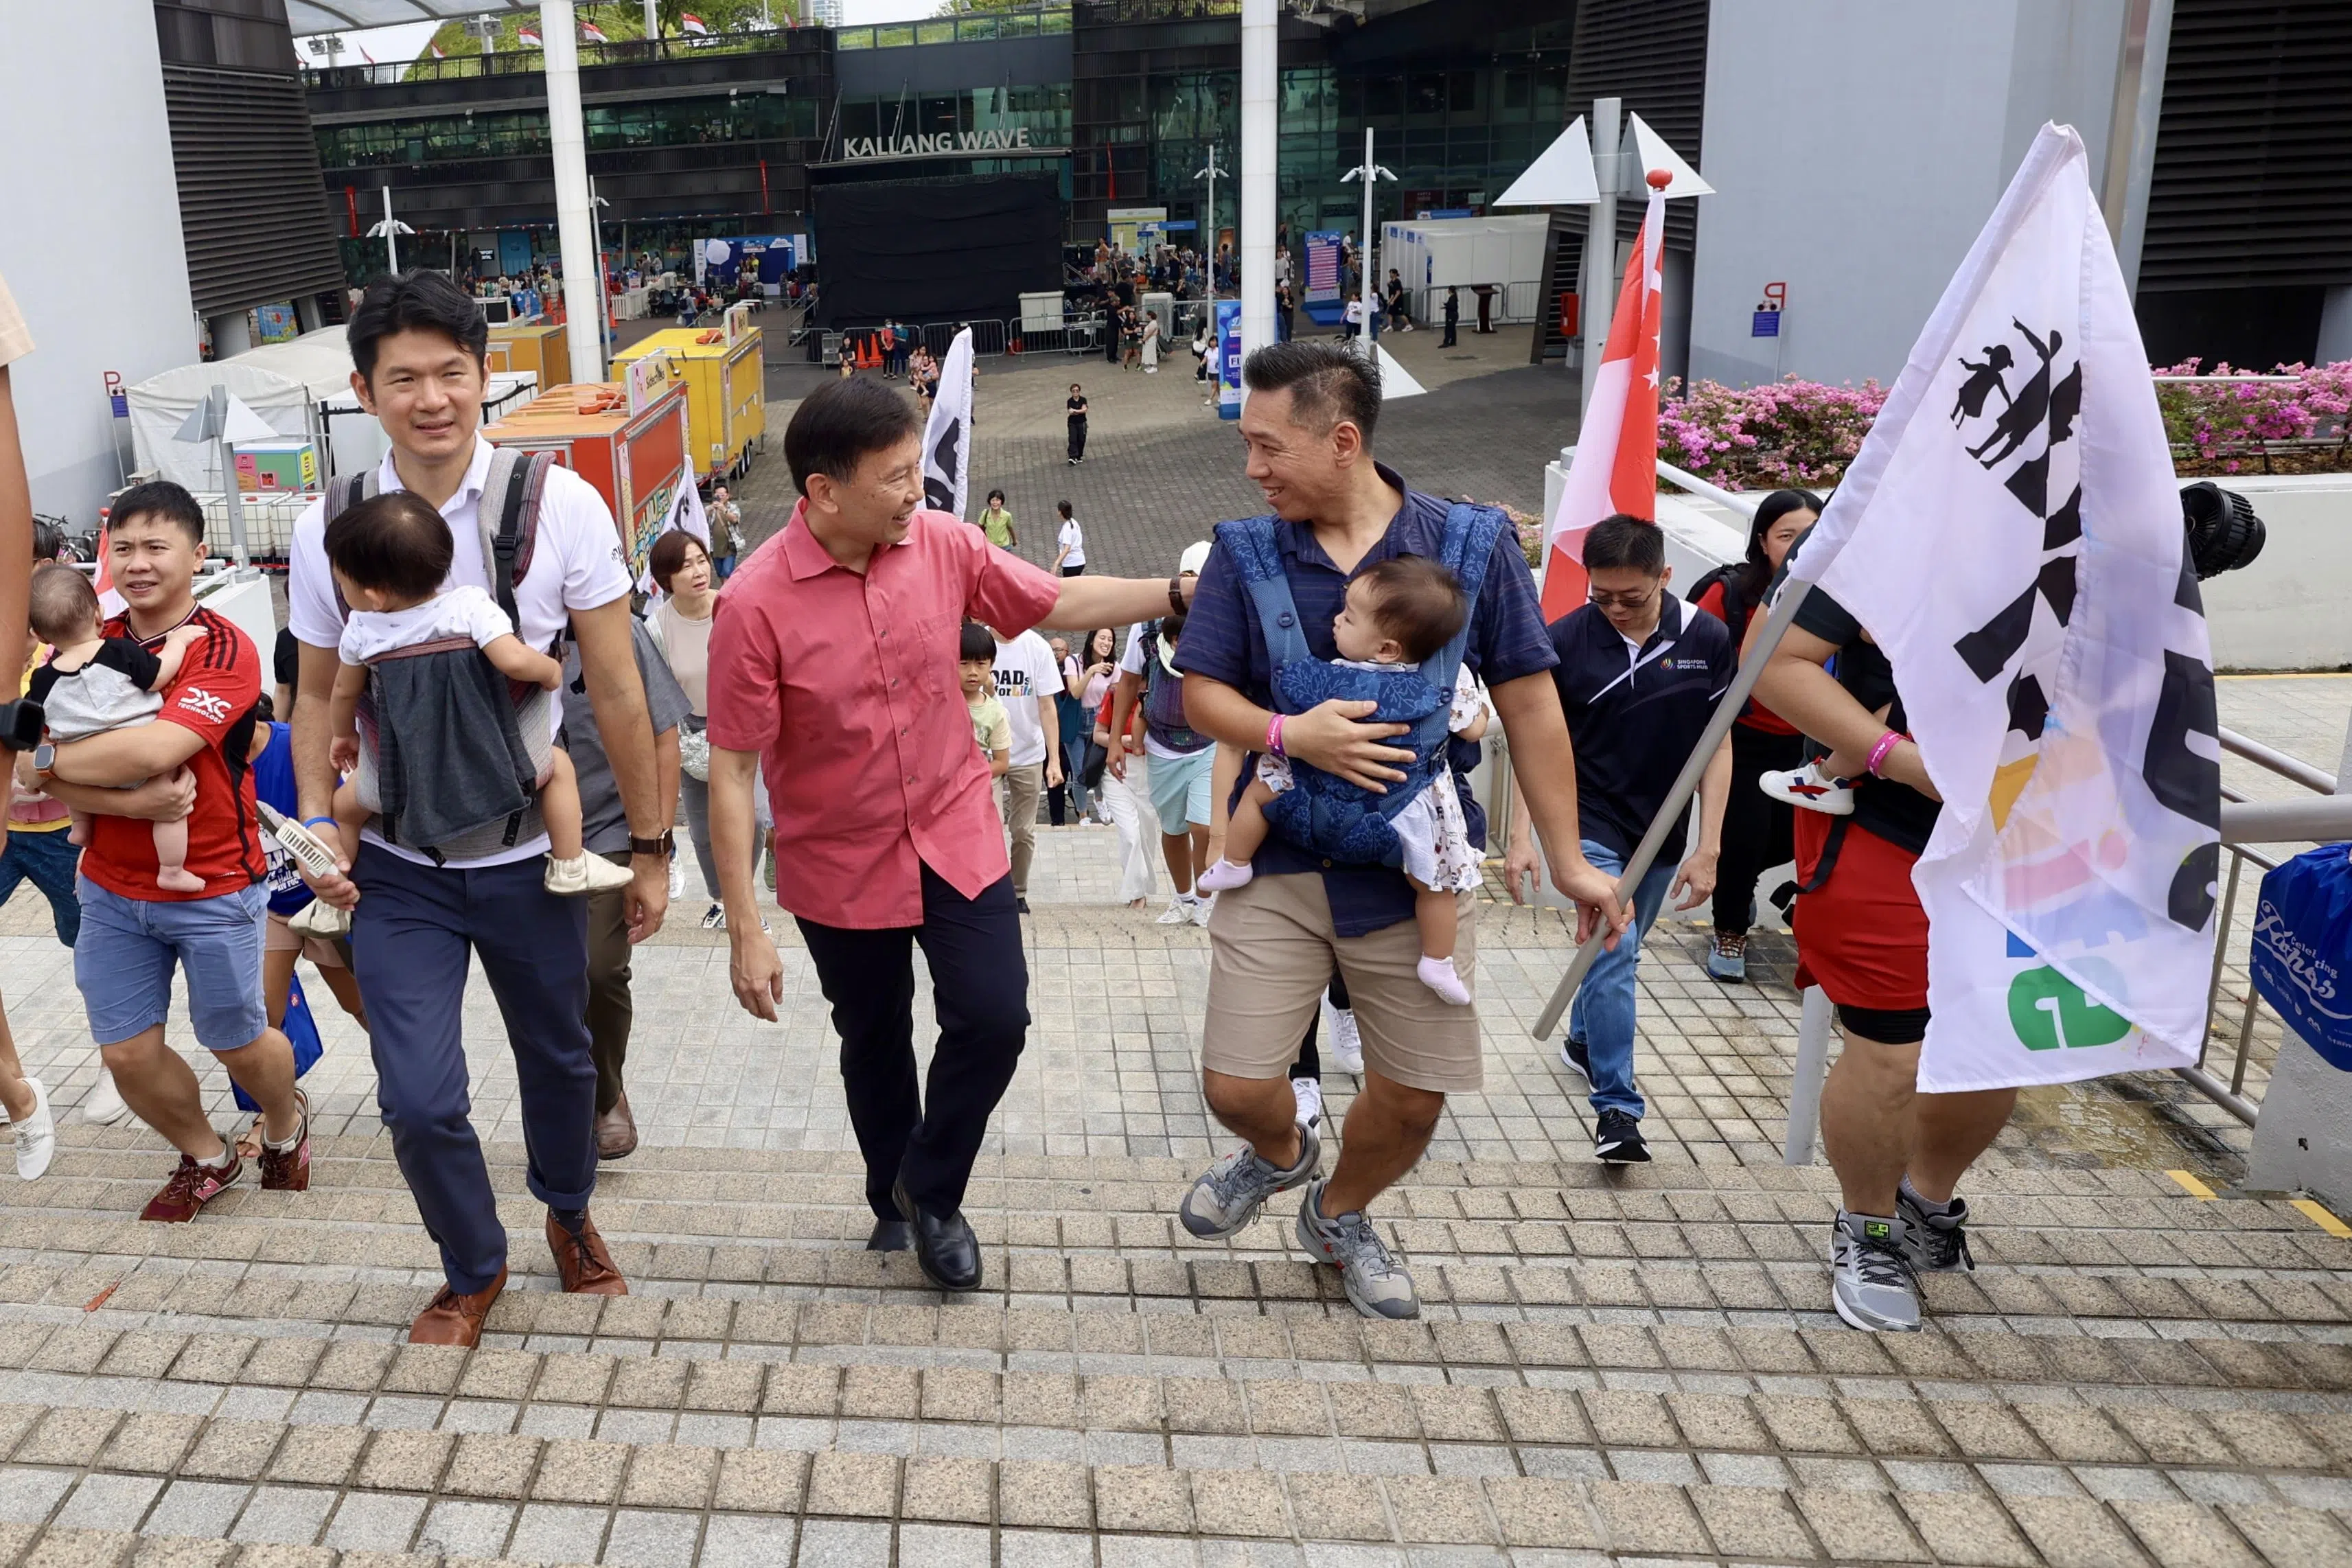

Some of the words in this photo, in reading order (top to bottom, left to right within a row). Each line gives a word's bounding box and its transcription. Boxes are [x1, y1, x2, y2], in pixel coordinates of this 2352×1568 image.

[844, 132, 952, 157] KALLANG
[958, 128, 1030, 150] WAVE
[104, 371, 121, 393] P
[178, 702, 222, 724] TECHNOLOGY
[180, 687, 232, 719] DXC
